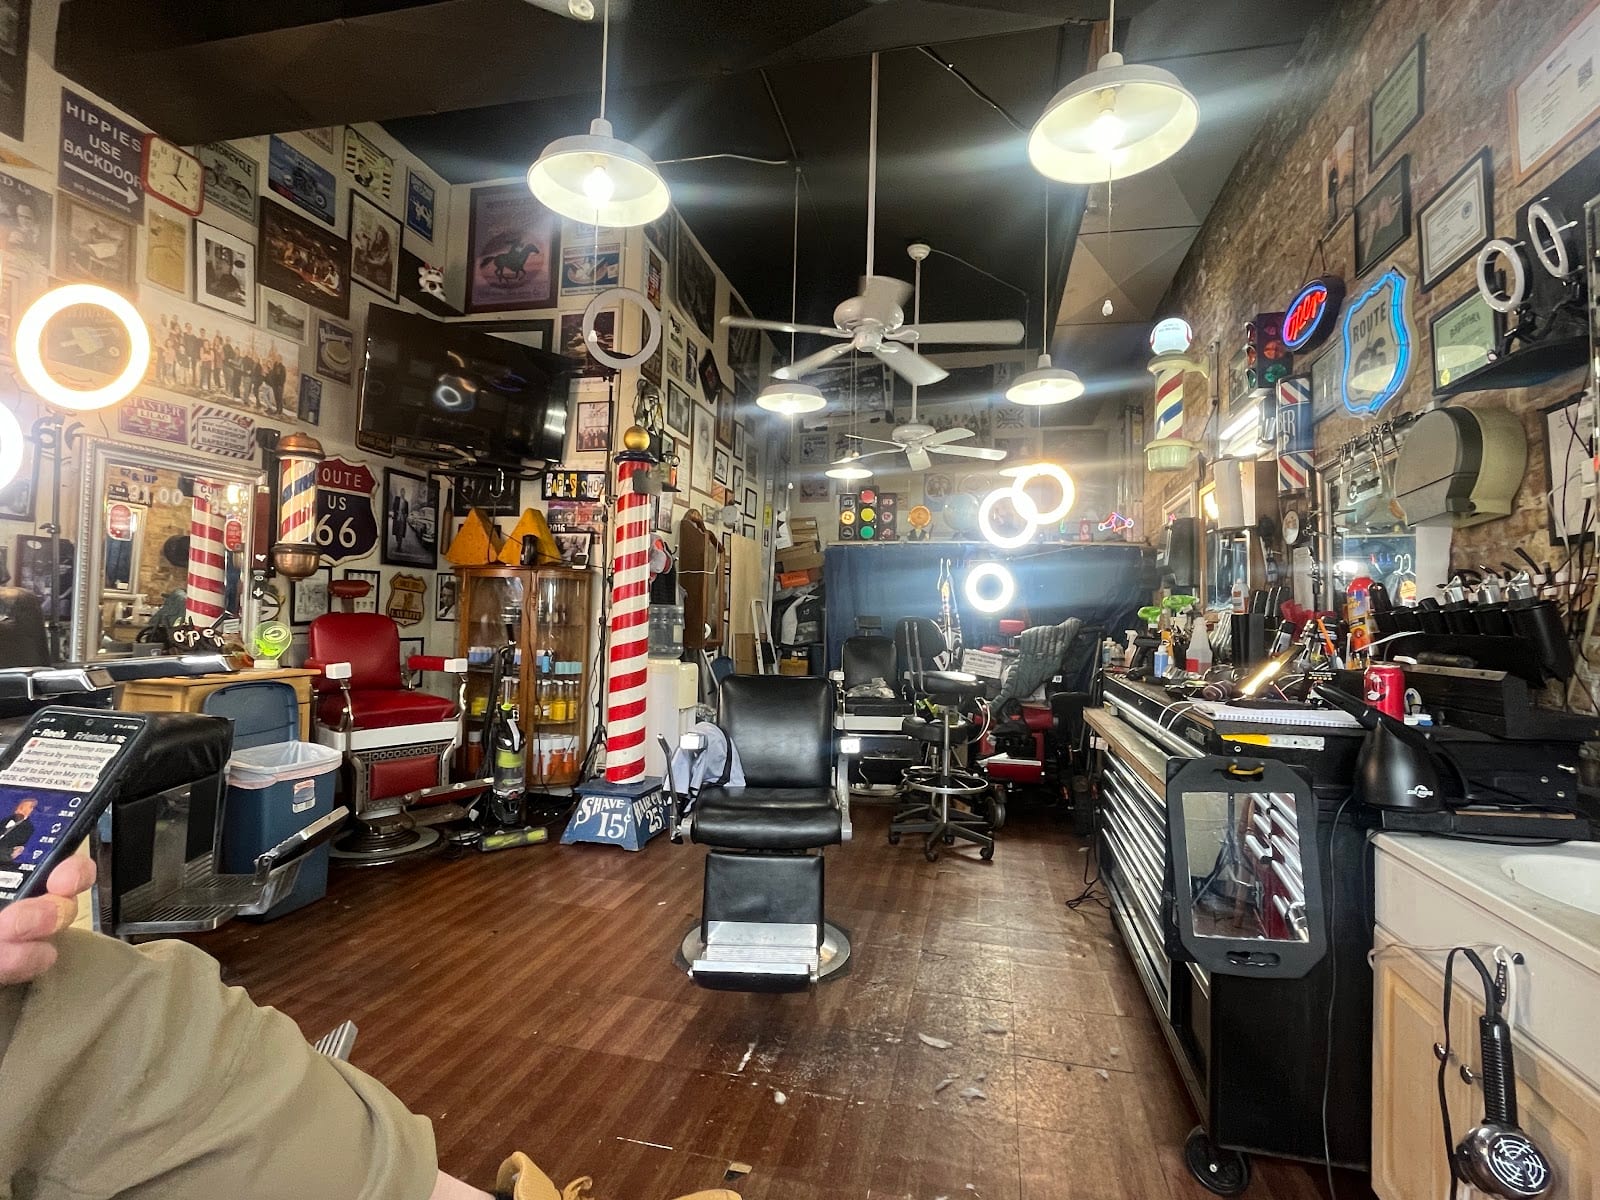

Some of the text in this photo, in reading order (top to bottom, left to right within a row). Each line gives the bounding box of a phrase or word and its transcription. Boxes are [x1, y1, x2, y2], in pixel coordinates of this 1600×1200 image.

[66, 101, 142, 153] HIPPIES
[89, 134, 121, 161] USE
[64, 139, 142, 190] BACKDOOR
[1353, 301, 1387, 344] ROUTE
[322, 467, 363, 488] OUTE
[327, 495, 348, 511] US
[316, 514, 357, 548] 66
[173, 628, 225, 648] open
[40, 728, 109, 742] Reels Friends
[25, 749, 106, 764] America by announcing
[38, 741, 72, 750] President
[72, 743, 94, 753] Trump
[18, 758, 101, 770] America will re-dedicate
[29, 767, 38, 775] to
[39, 768, 52, 776] God
[63, 770, 79, 779] May
[18, 775, 45, 784] CHRIST
[46, 777, 53, 785] IS
[54, 777, 73, 786] KING
[573, 796, 627, 831] SHAVE
